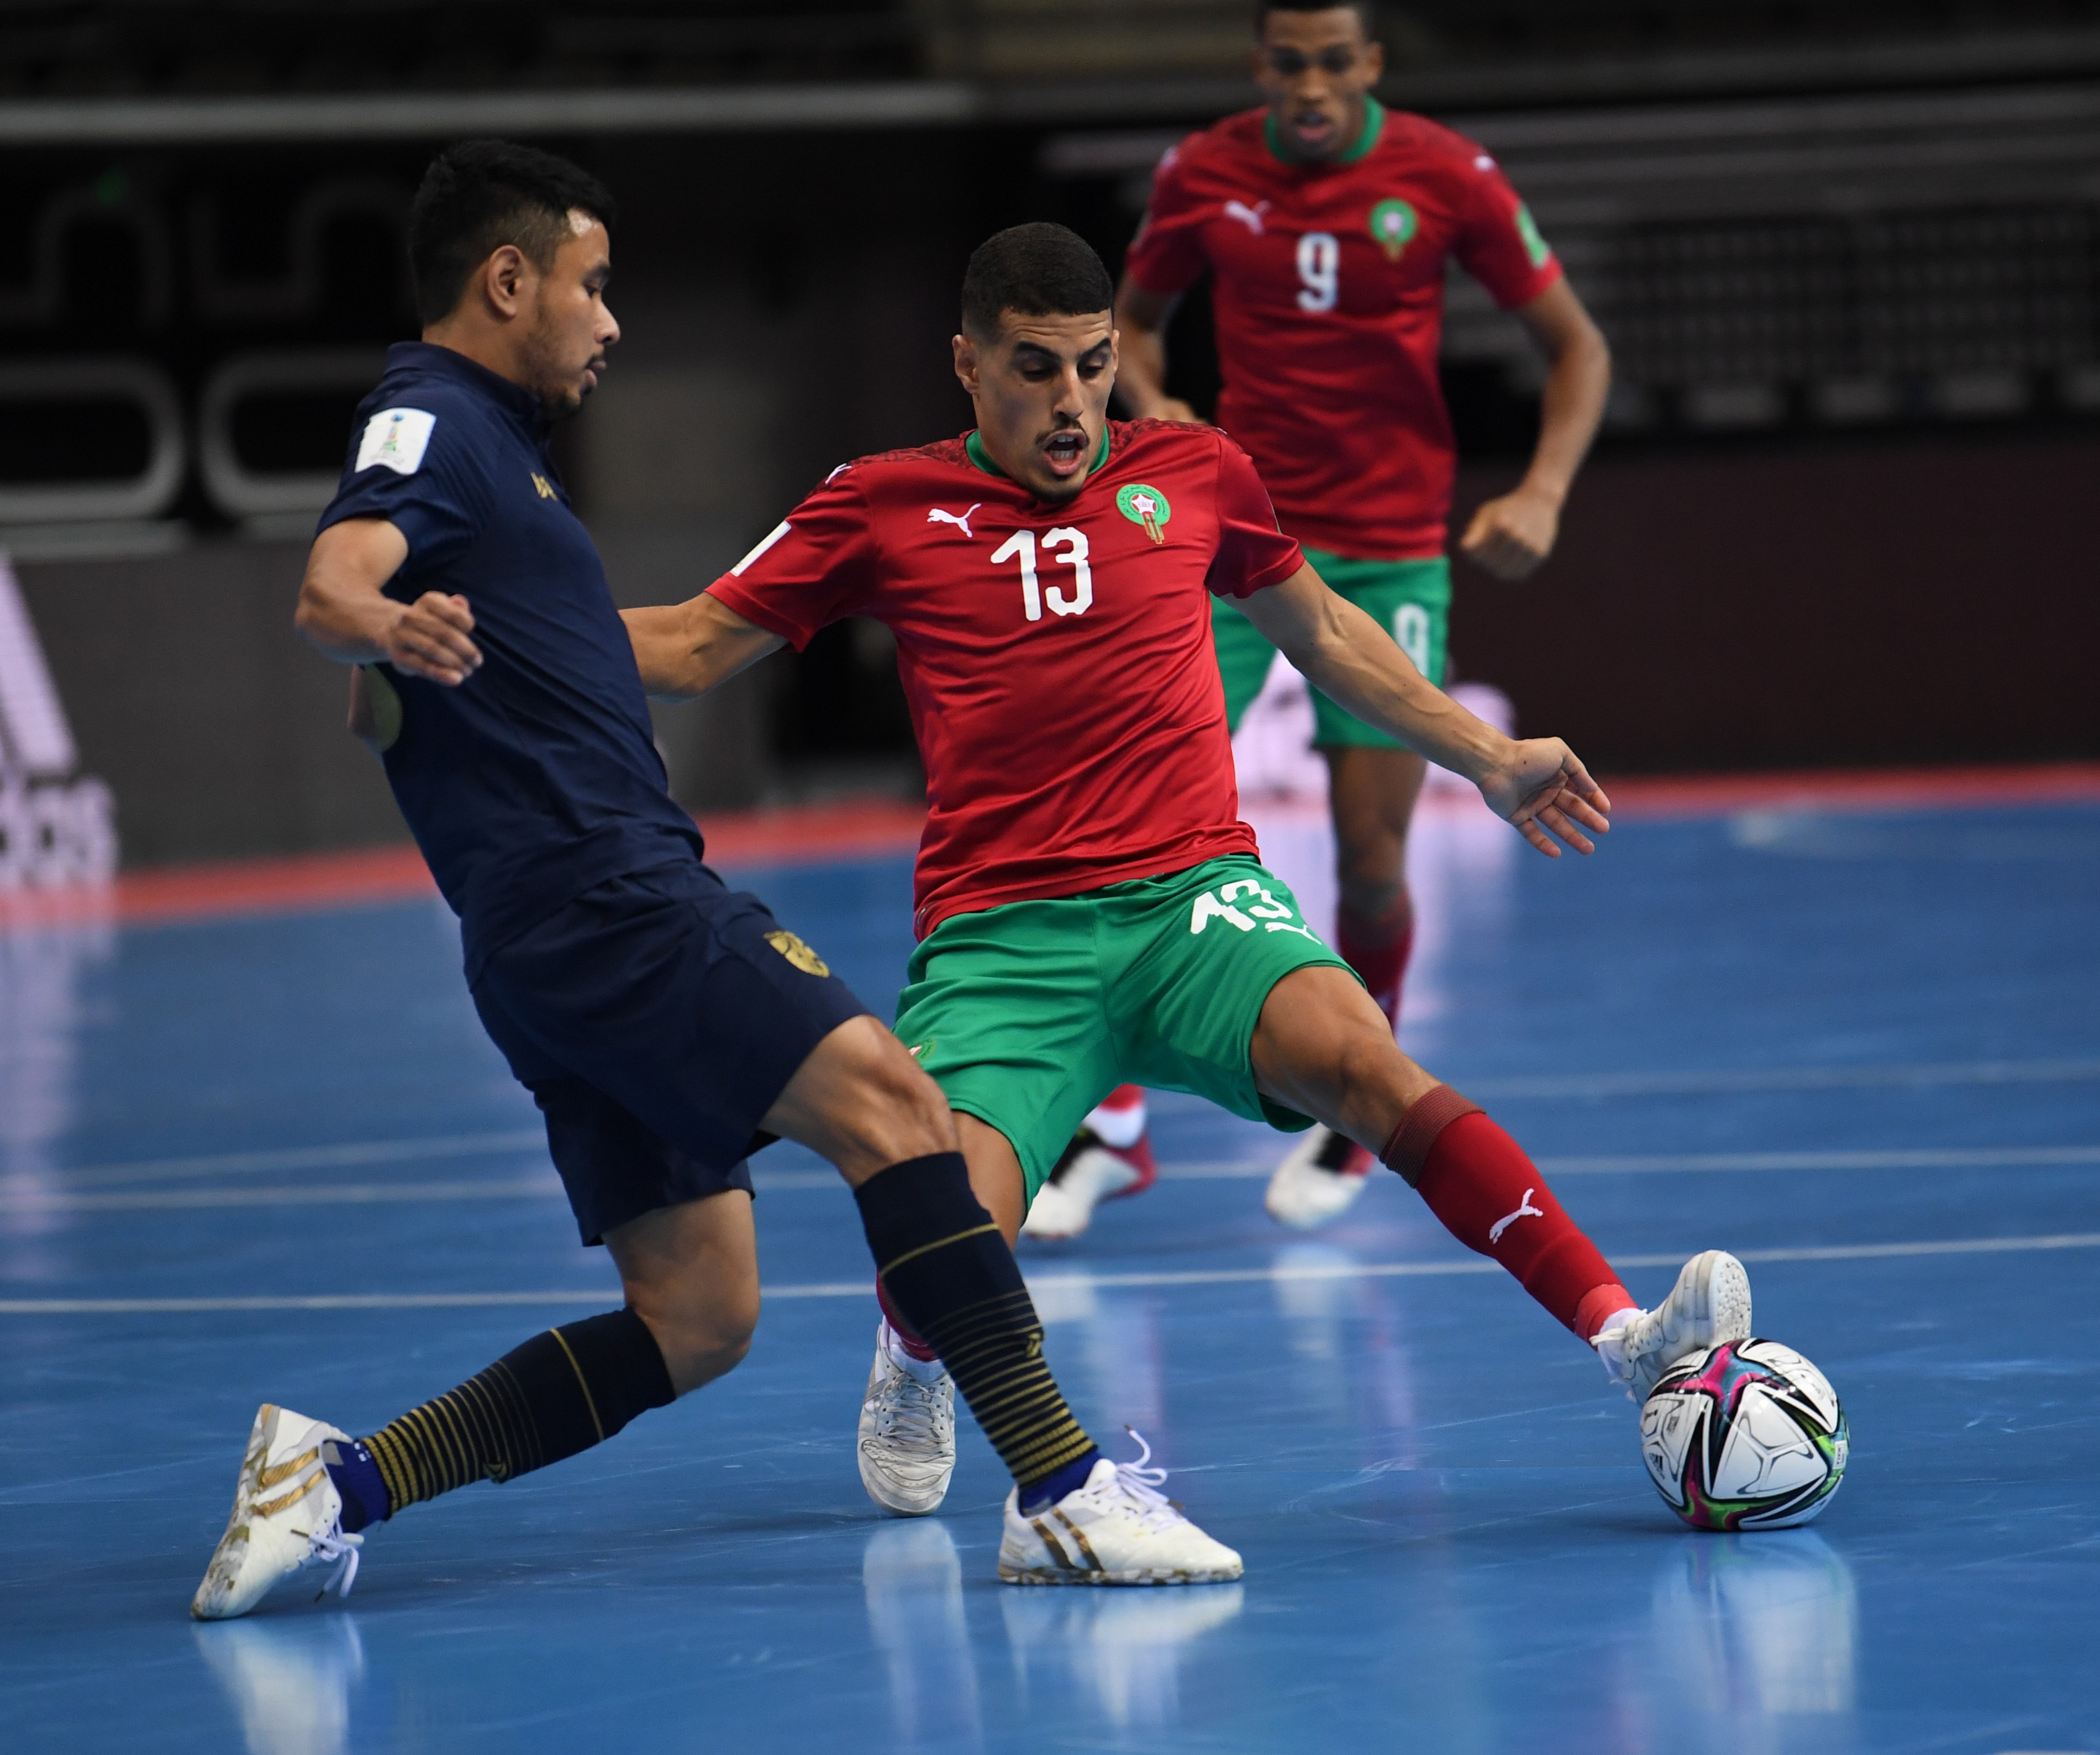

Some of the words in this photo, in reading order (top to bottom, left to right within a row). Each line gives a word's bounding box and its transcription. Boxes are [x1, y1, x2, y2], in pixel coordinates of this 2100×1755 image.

[1296, 232, 1339, 314] 9
[990, 527, 1093, 621] 13
[1394, 603, 1430, 677] 9
[1190, 879, 1293, 934] 13
